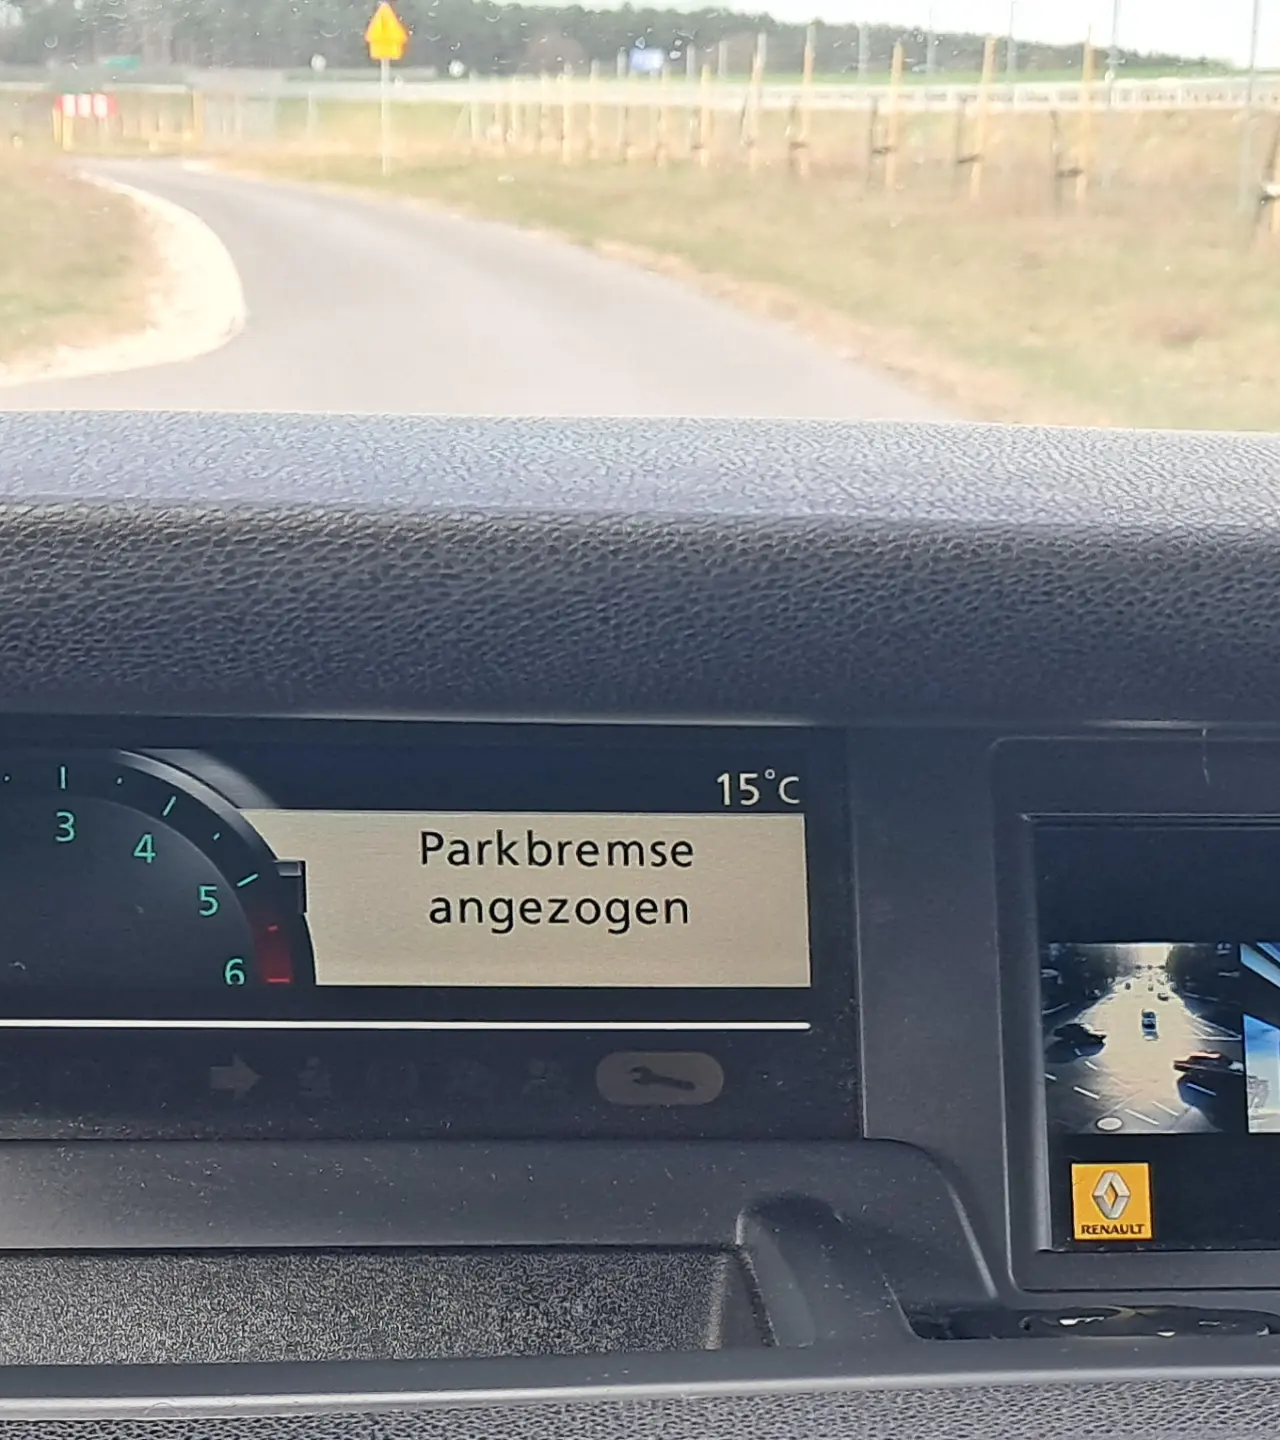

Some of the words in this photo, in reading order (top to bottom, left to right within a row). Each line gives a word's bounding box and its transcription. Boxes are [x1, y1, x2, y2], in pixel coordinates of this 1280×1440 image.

[54, 811, 76, 844] 3
[133, 833, 157, 864] 4
[420, 829, 695, 868] Parkbremse
[199, 886, 219, 916] 5
[428, 894, 691, 934] angezogen
[224, 958, 246, 986] 6
[1080, 1223, 1145, 1235] RENAULT
